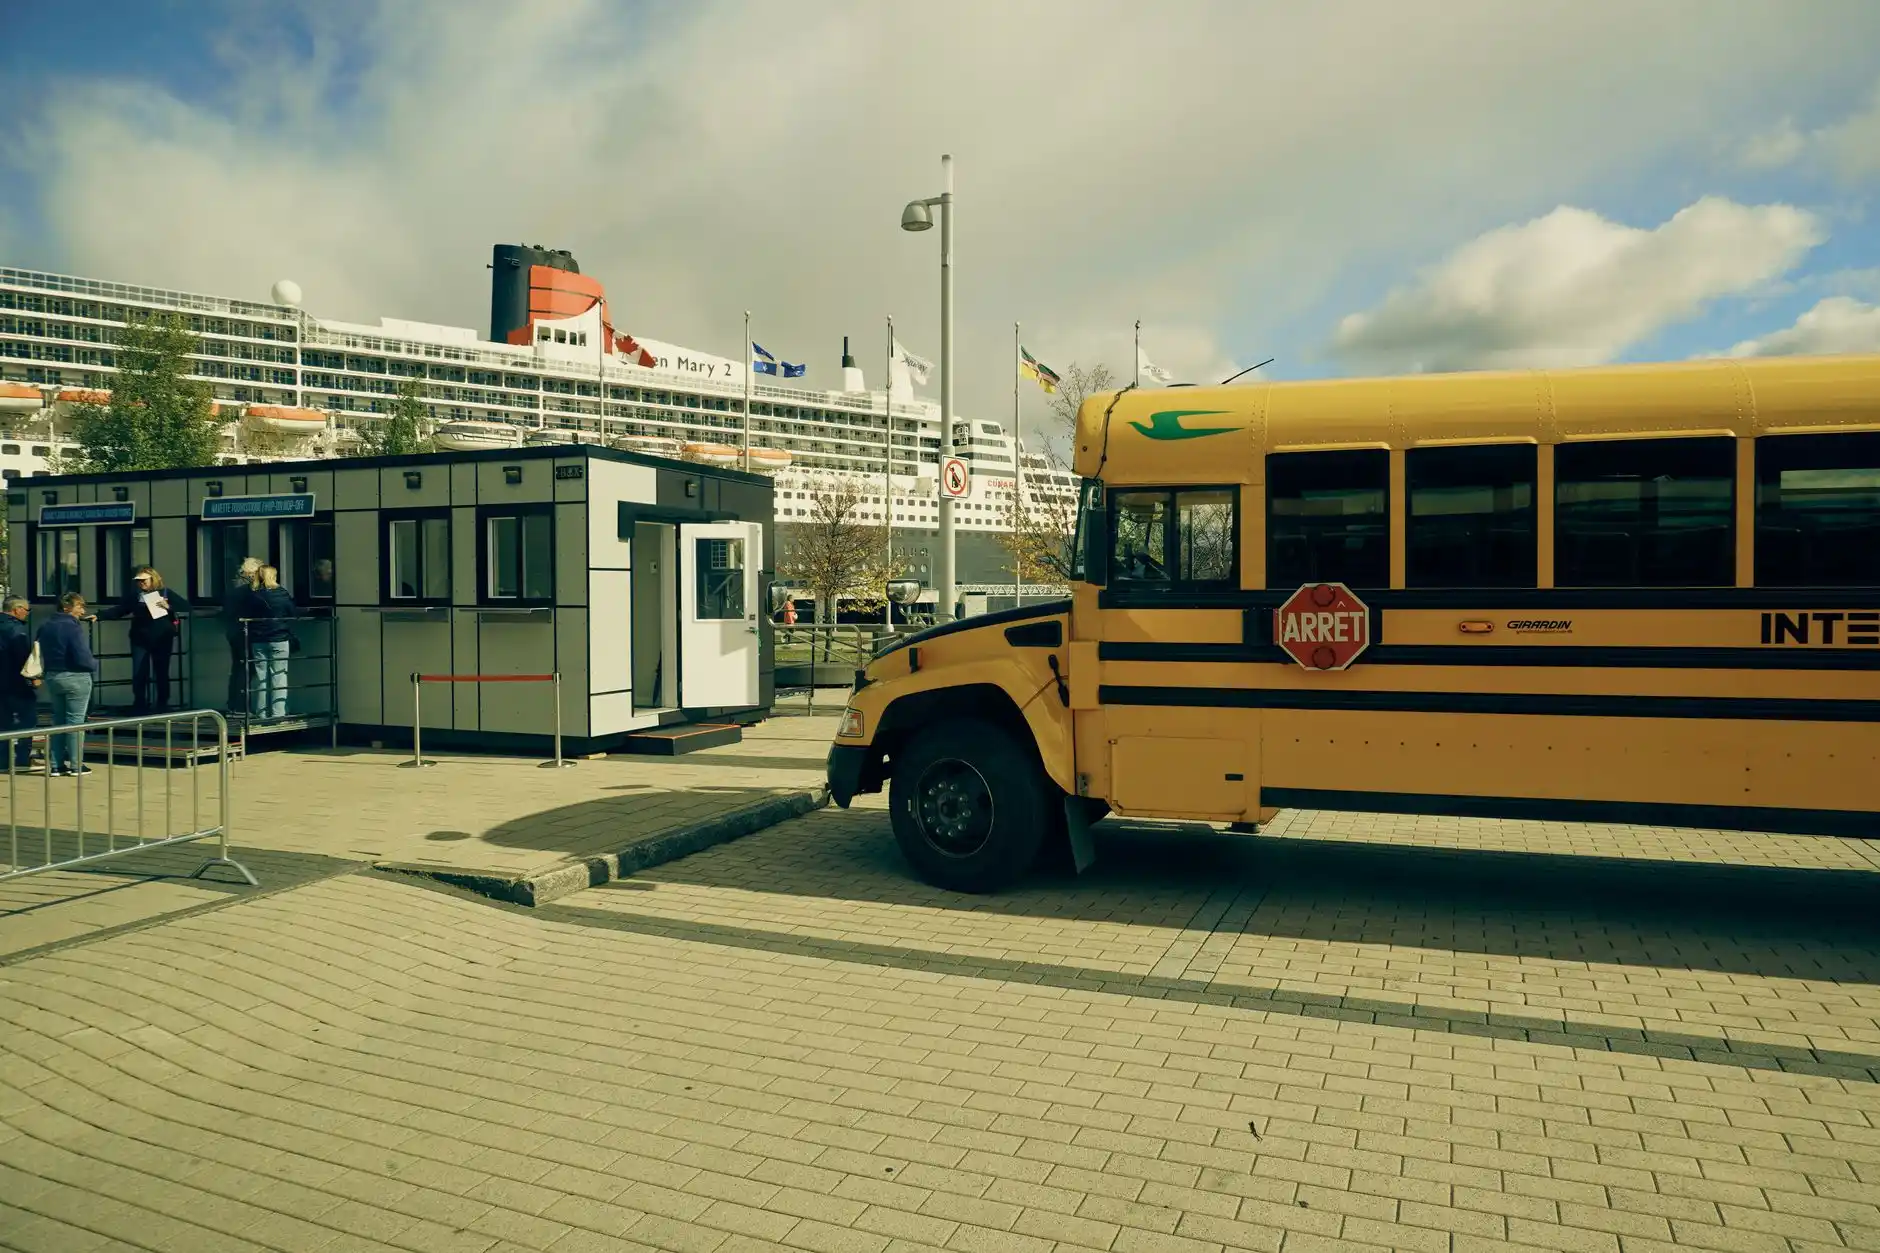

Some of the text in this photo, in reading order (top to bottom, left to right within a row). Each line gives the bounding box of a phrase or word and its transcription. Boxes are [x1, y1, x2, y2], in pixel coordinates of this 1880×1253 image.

[678, 356, 715, 377] Mary
[724, 363, 732, 376] 2
[988, 480, 1016, 489] CUNAR
[1283, 601, 1364, 642] ARRÊT
[1507, 620, 1572, 629] GIRARDIN
[1761, 612, 1879, 644] INTE
